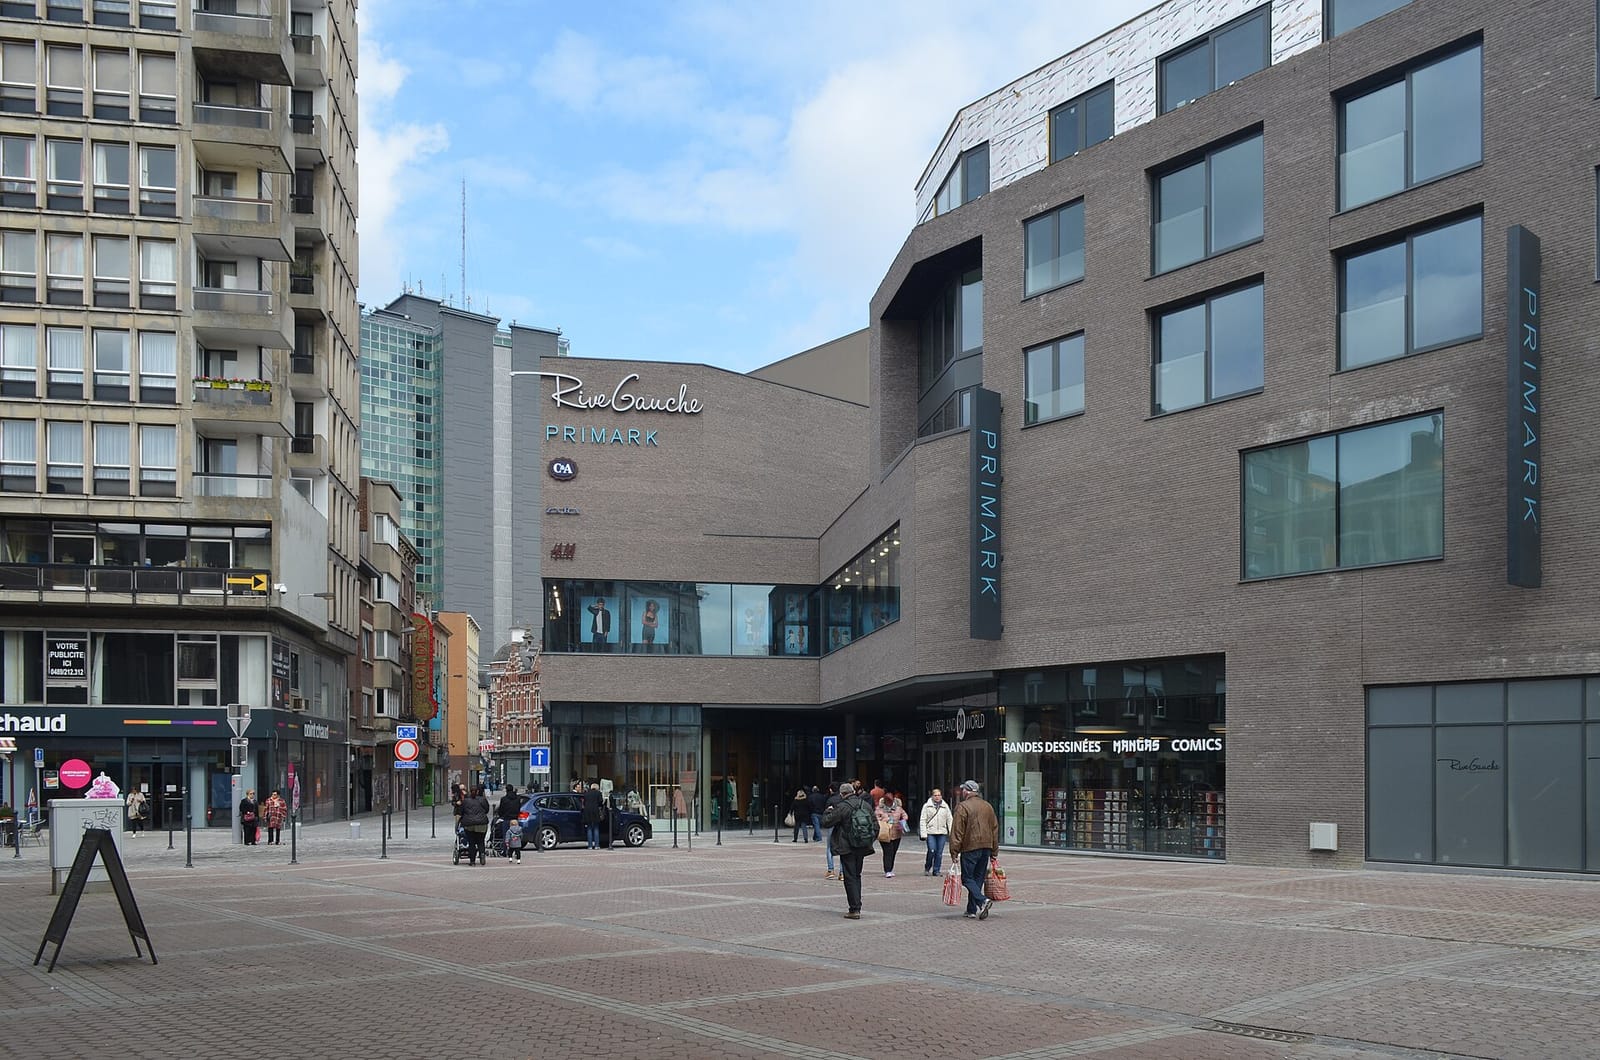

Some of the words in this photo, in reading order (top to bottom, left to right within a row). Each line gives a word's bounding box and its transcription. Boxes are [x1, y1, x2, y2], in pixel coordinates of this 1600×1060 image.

[1523, 286, 1538, 523] PRIMARK
[546, 424, 659, 446] PRIMARK
[552, 462, 574, 474] C&A
[980, 429, 998, 597] PRIMARK
[55, 642, 79, 650] VOTRE
[49, 651, 85, 659] PUBLICITE
[62, 659, 72, 667] ICI
[415, 623, 427, 692] GOLDEN
[0, 713, 66, 732] haud
[966, 713, 985, 730] WORLD
[1003, 741, 1044, 753] BANDES
[1045, 738, 1101, 753] DESSINÉES
[1113, 739, 1160, 754] MANGAS
[1171, 738, 1222, 752] COMICS
